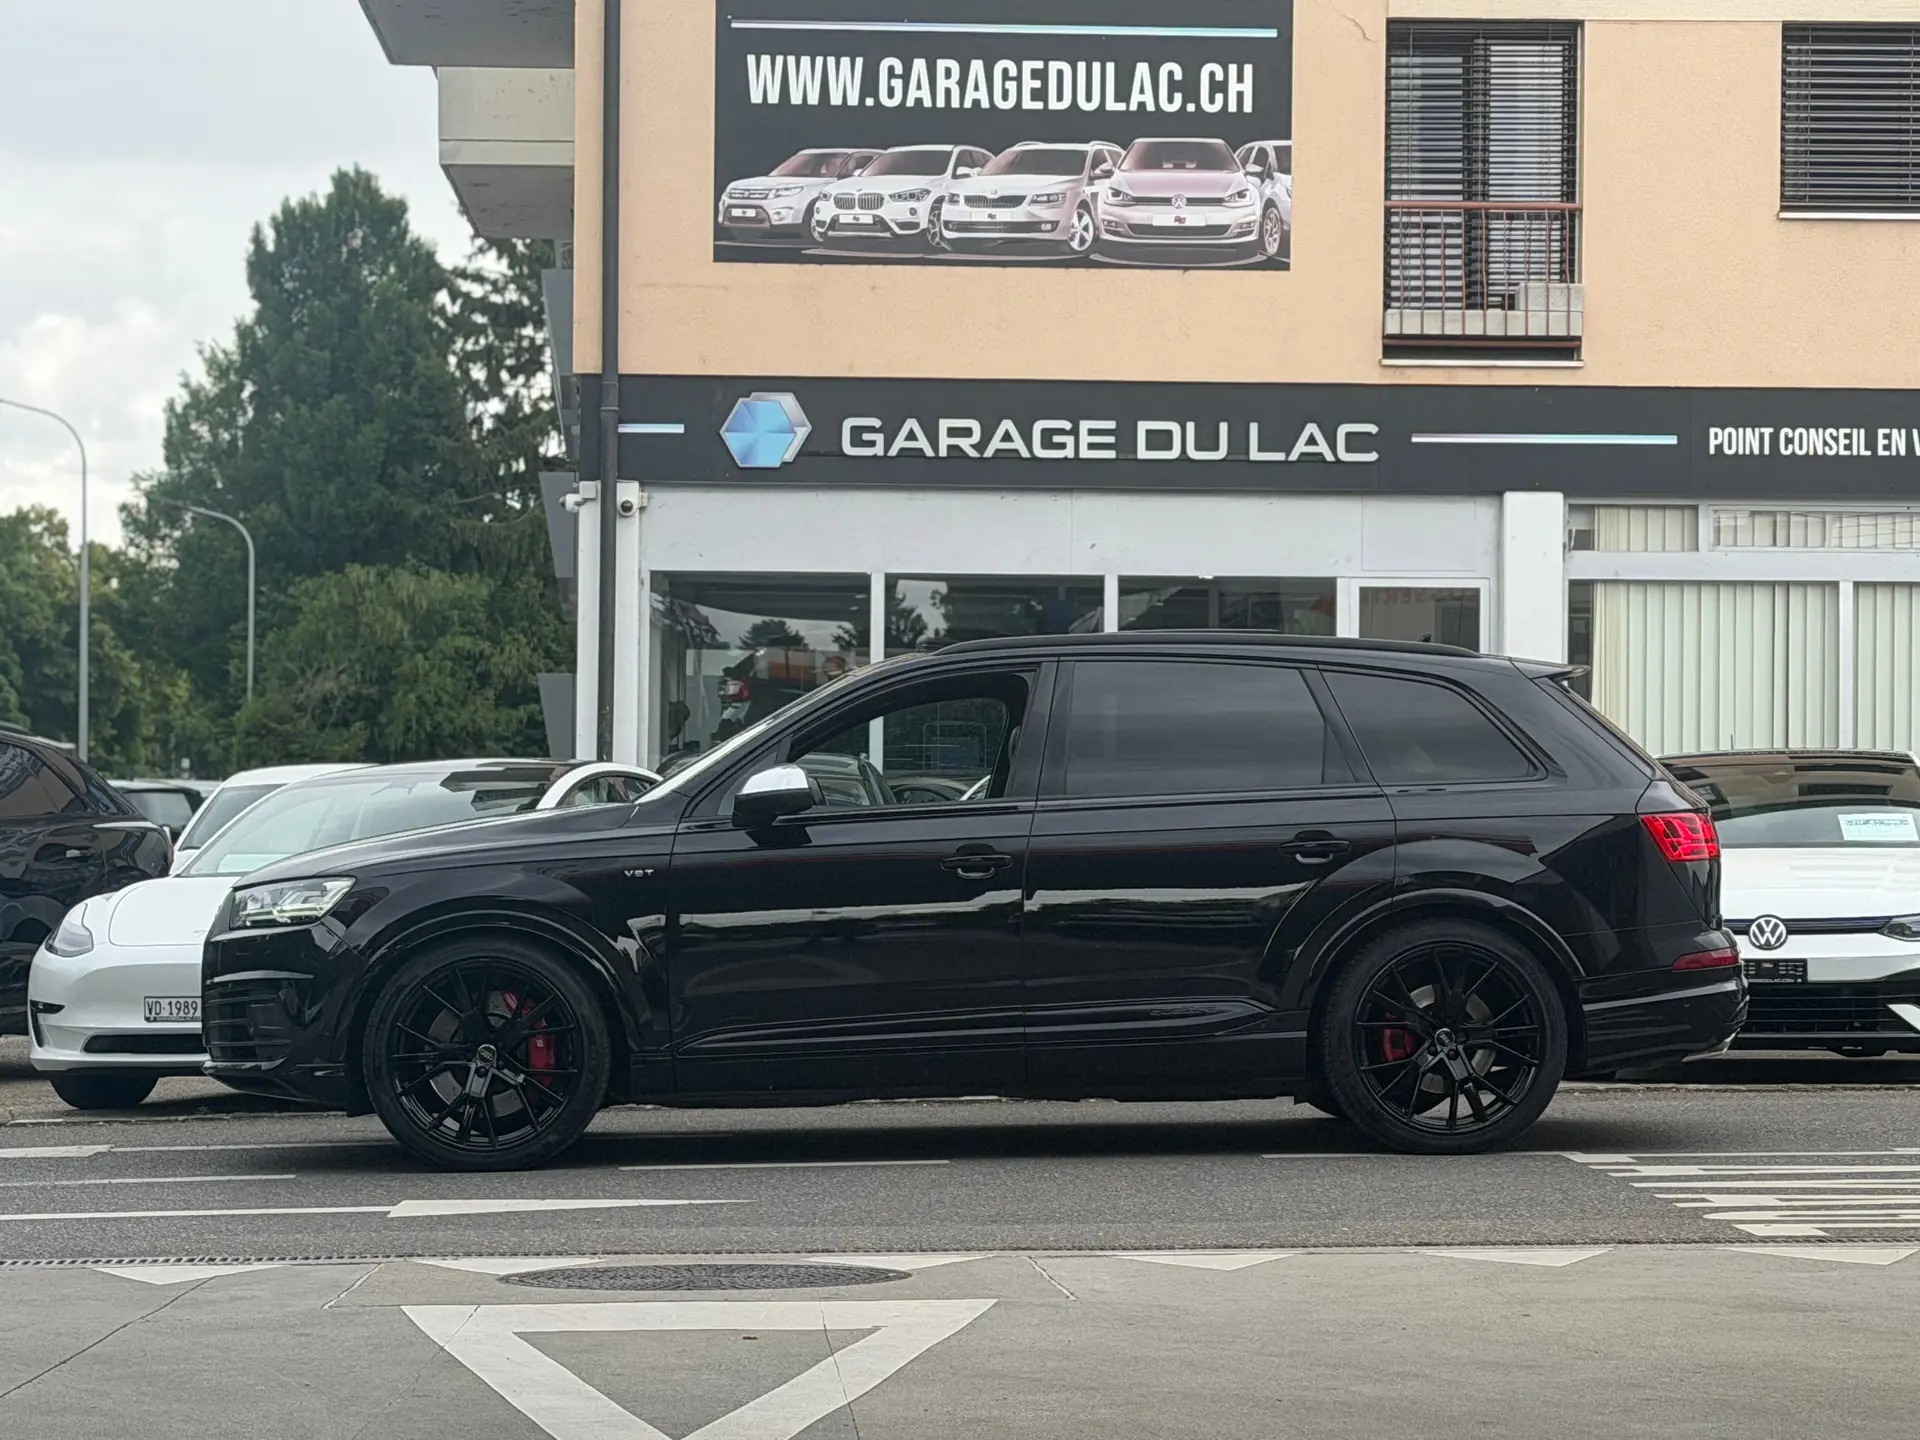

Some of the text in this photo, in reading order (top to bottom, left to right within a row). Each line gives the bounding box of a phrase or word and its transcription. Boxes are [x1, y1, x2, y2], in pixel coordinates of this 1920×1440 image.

[746, 54, 1253, 114] WWW.GARAGEDULAC.CH
[841, 417, 1380, 462] GARAGE DU LAC
[1709, 426, 1775, 456] POINT
[1779, 427, 1872, 456] CONSEIL
[1877, 428, 1907, 457] EN
